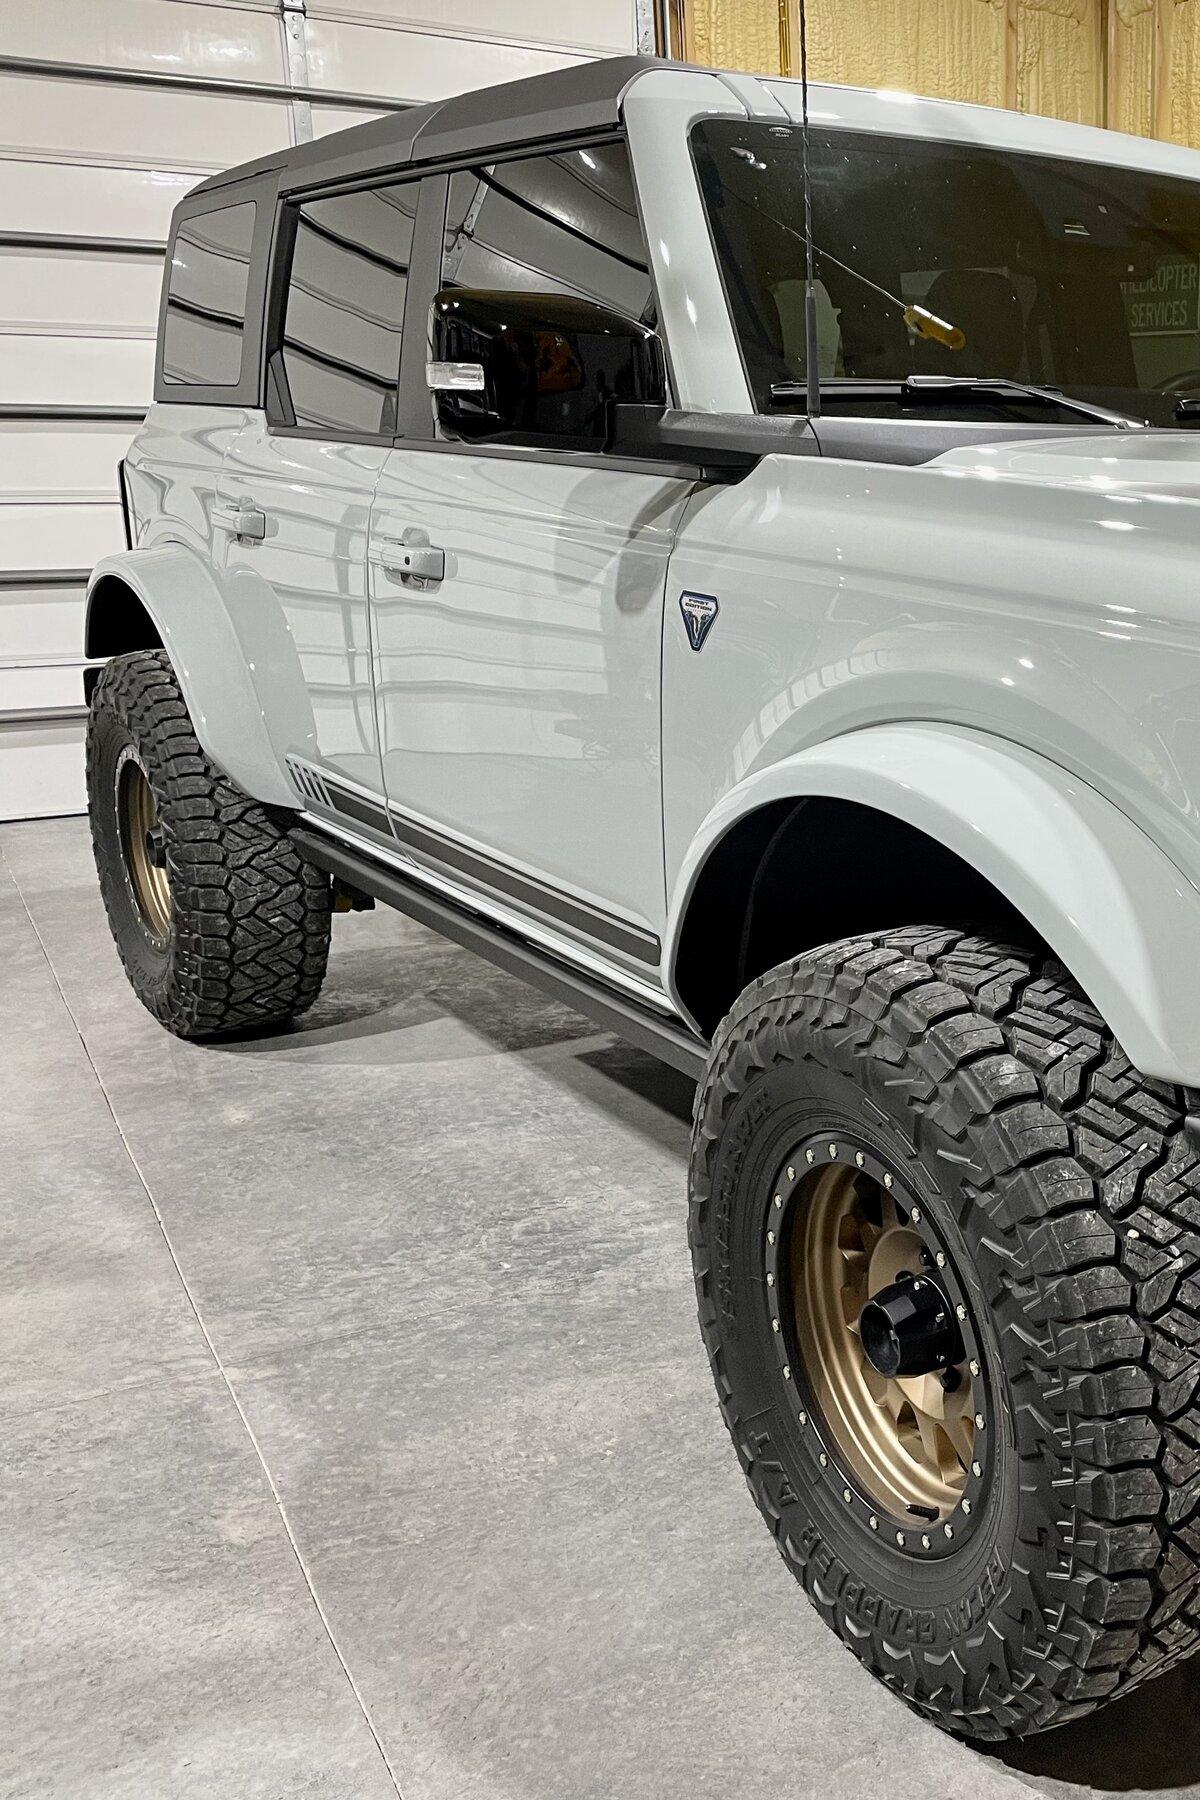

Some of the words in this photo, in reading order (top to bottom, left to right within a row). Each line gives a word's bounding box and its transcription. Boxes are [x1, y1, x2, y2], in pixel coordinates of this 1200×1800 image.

[1129, 299, 1188, 328] SERVICES
[685, 602, 712, 611] EDITION
[801, 1519, 936, 1643] GRAPPLER
